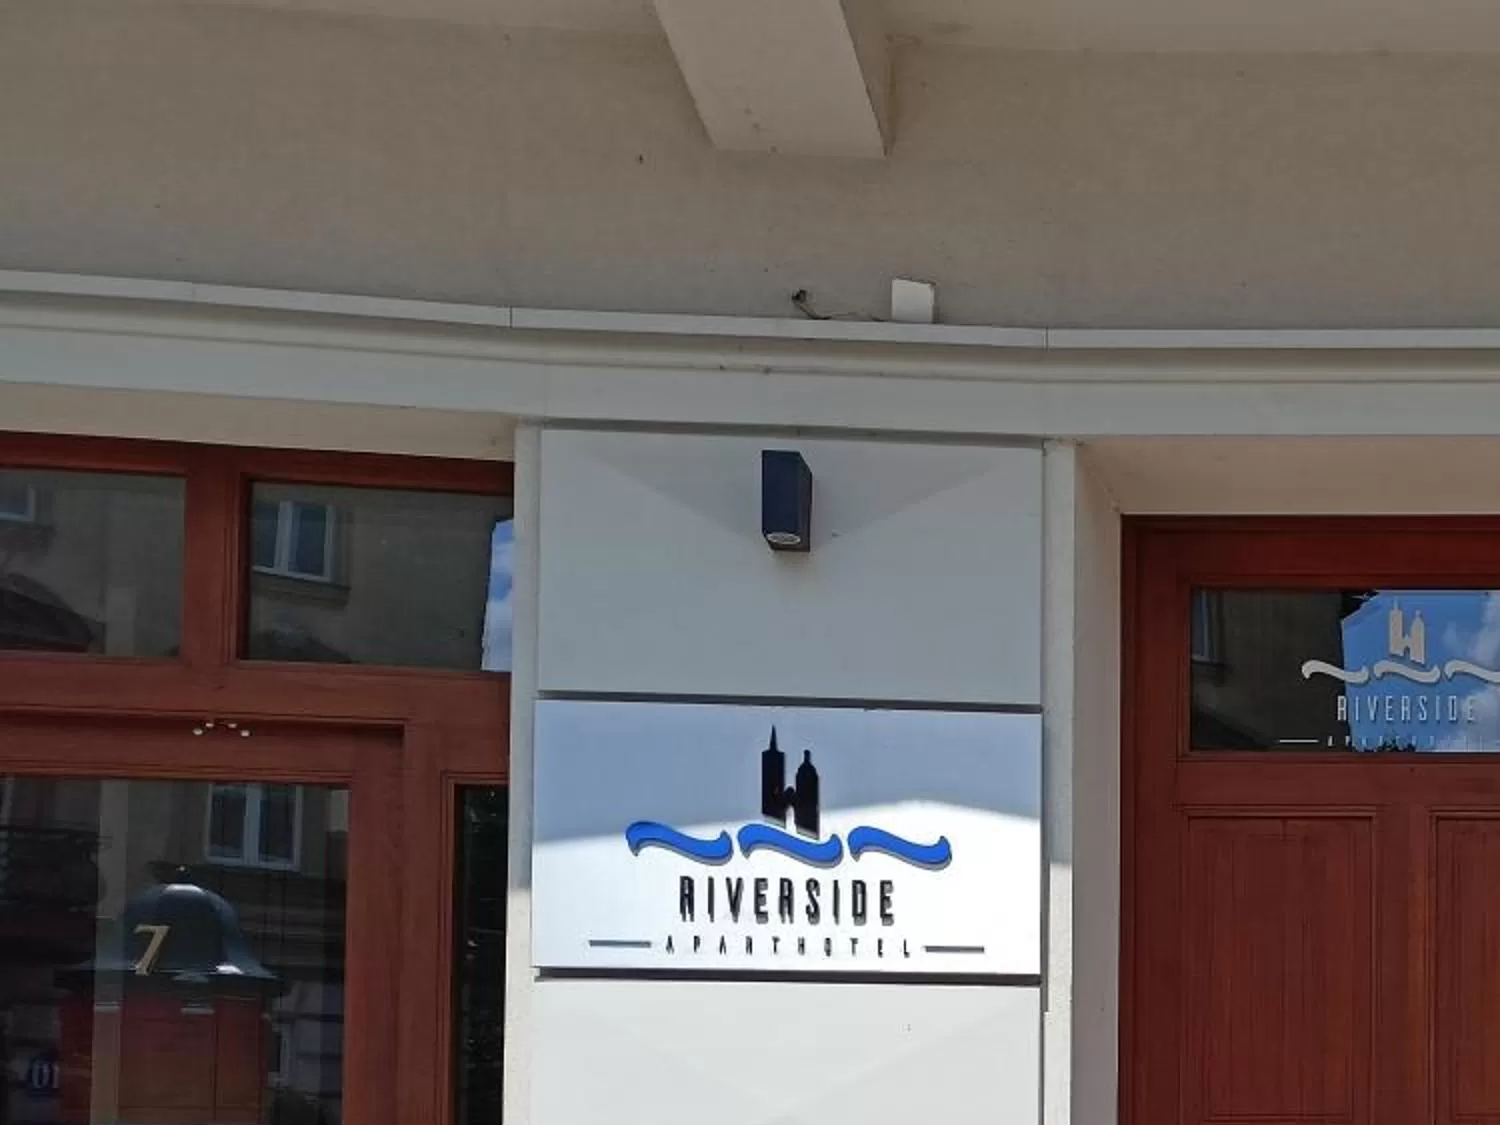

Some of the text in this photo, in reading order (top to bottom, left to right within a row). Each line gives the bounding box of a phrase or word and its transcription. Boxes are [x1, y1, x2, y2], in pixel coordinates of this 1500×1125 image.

[1337, 695, 1476, 722] RIVERSIDE
[679, 875, 895, 925] RIVERSIDE
[134, 924, 170, 976] 7
[665, 935, 910, 958] APARTHOTEL
